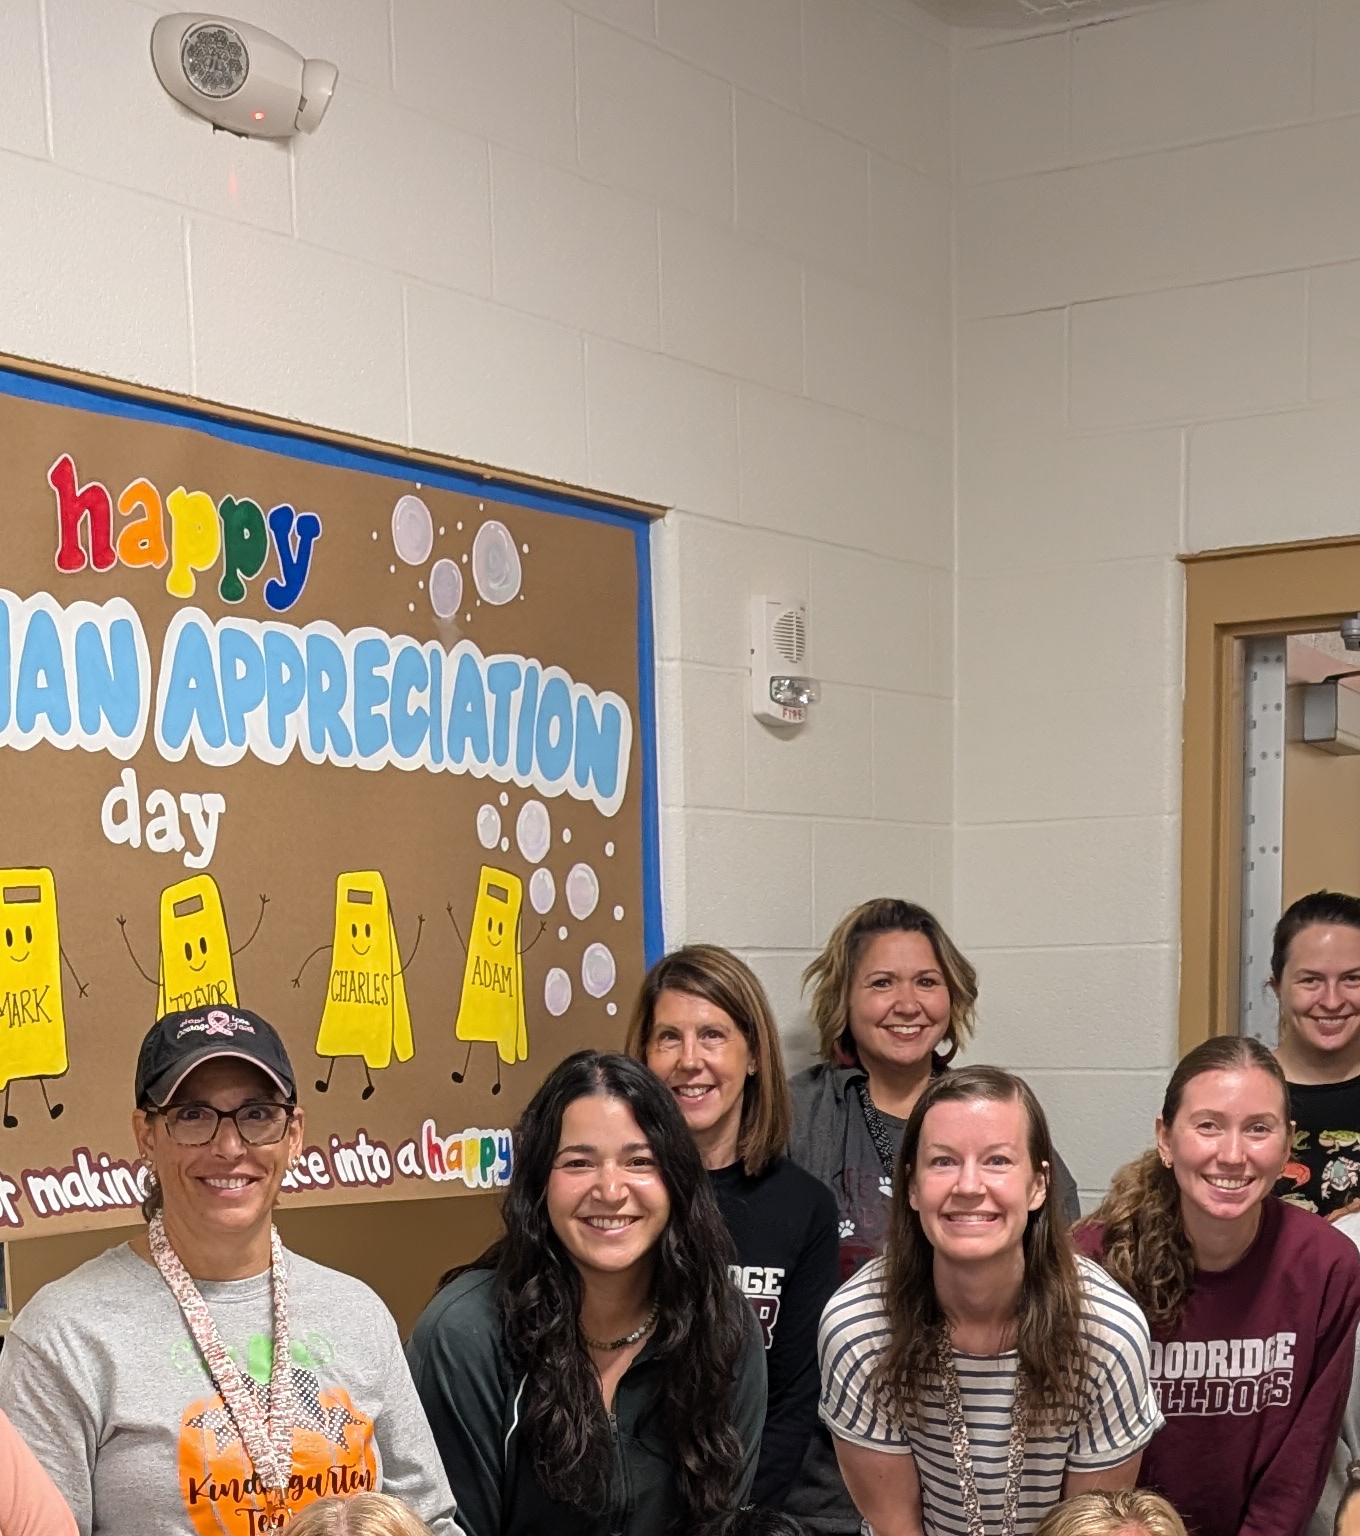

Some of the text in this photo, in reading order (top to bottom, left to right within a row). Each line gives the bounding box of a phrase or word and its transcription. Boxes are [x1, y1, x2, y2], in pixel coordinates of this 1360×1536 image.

[49, 453, 322, 612] happy
[158, 612, 628, 806] APPRECIATION
[782, 707, 803, 721] FIRE
[101, 770, 227, 867] day
[170, 980, 234, 1012] TREVOR
[329, 968, 390, 1007] CHARLES
[471, 957, 513, 999] ADAM
[330, 1132, 390, 1184] into
[397, 1142, 423, 1177] a
[423, 1120, 514, 1187] happy
[1149, 1332, 1297, 1379] OODRIDGE
[1150, 1370, 1294, 1417] LLDOGS
[189, 1464, 375, 1505] Kindgarten
